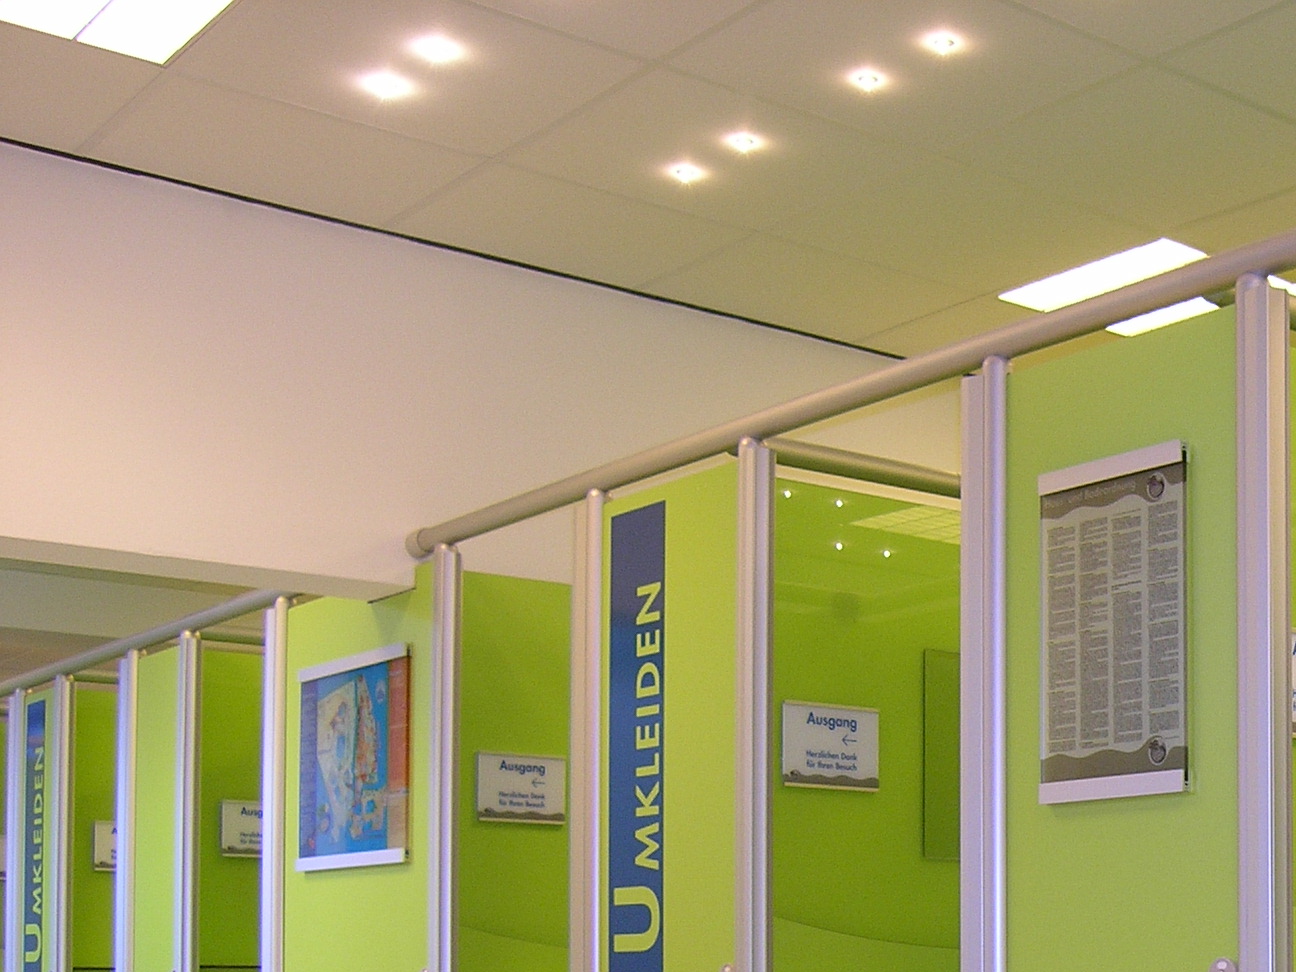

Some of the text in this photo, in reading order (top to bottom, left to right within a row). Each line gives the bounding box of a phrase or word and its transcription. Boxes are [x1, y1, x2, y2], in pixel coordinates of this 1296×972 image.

[806, 711, 857, 732] Ausgang
[840, 752, 857, 761] Dank
[499, 759, 546, 776] Ausgang
[613, 581, 662, 953] UMKLEIDEN
[241, 806, 263, 819] Ausg
[24, 746, 45, 963] UMKLEIDEN
